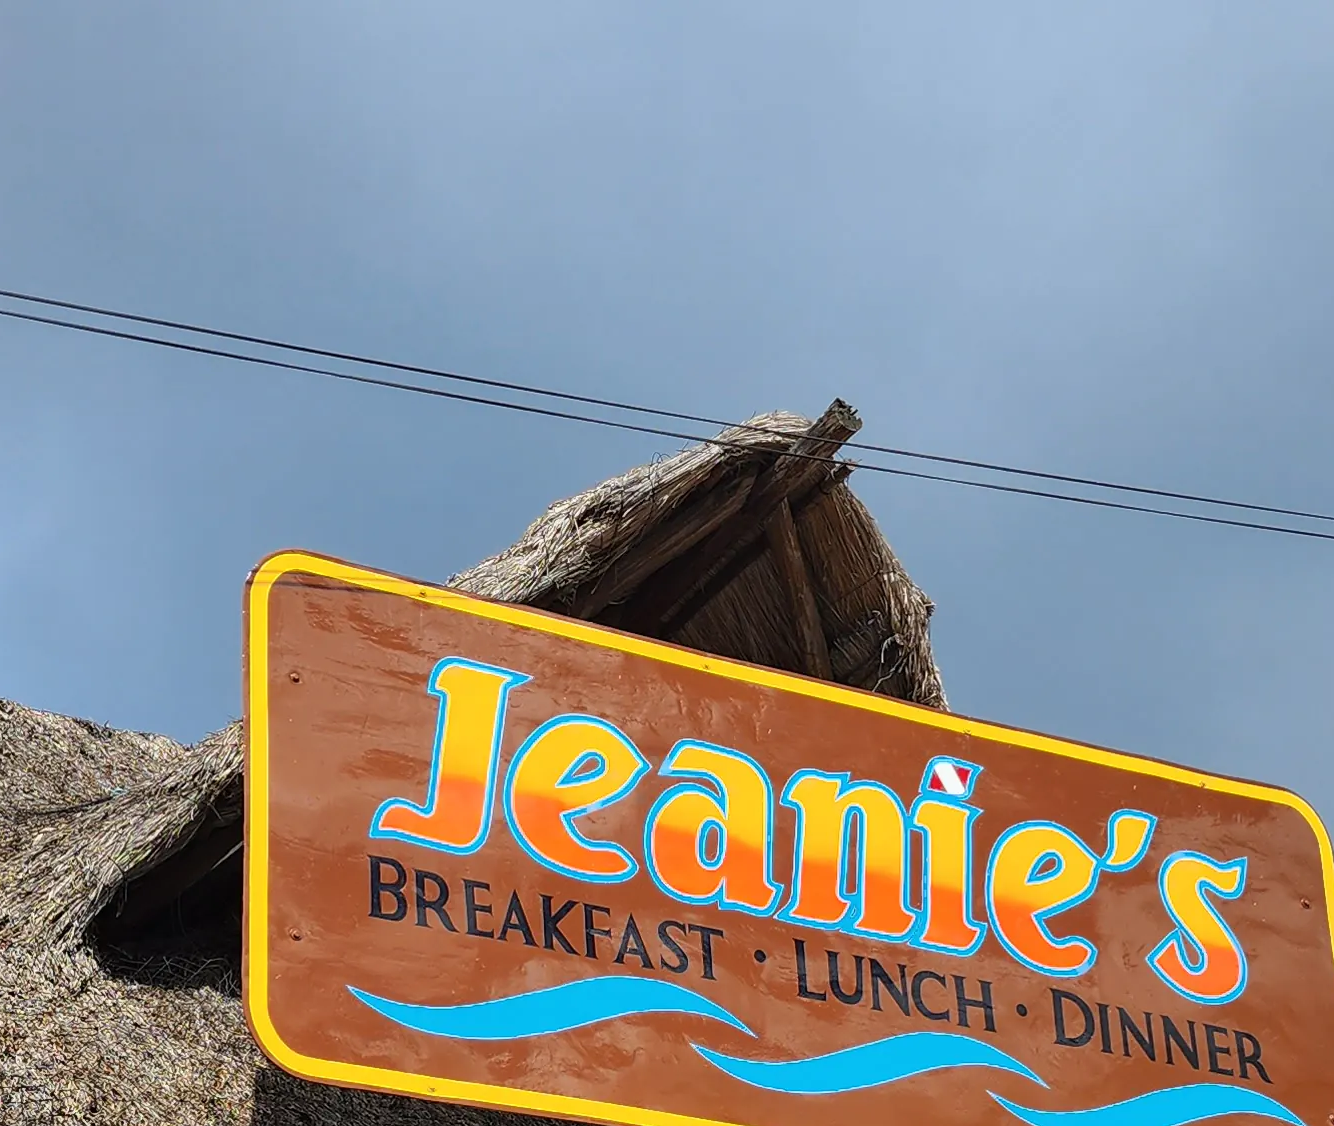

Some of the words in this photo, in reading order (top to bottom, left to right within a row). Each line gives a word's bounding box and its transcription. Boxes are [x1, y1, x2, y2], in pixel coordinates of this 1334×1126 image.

[368, 855, 724, 981] BREAKFAST
[792, 937, 998, 1033] LUNCH
[1049, 987, 1274, 1084] DINNER
[370, 656, 1249, 1005] Jeanie's
